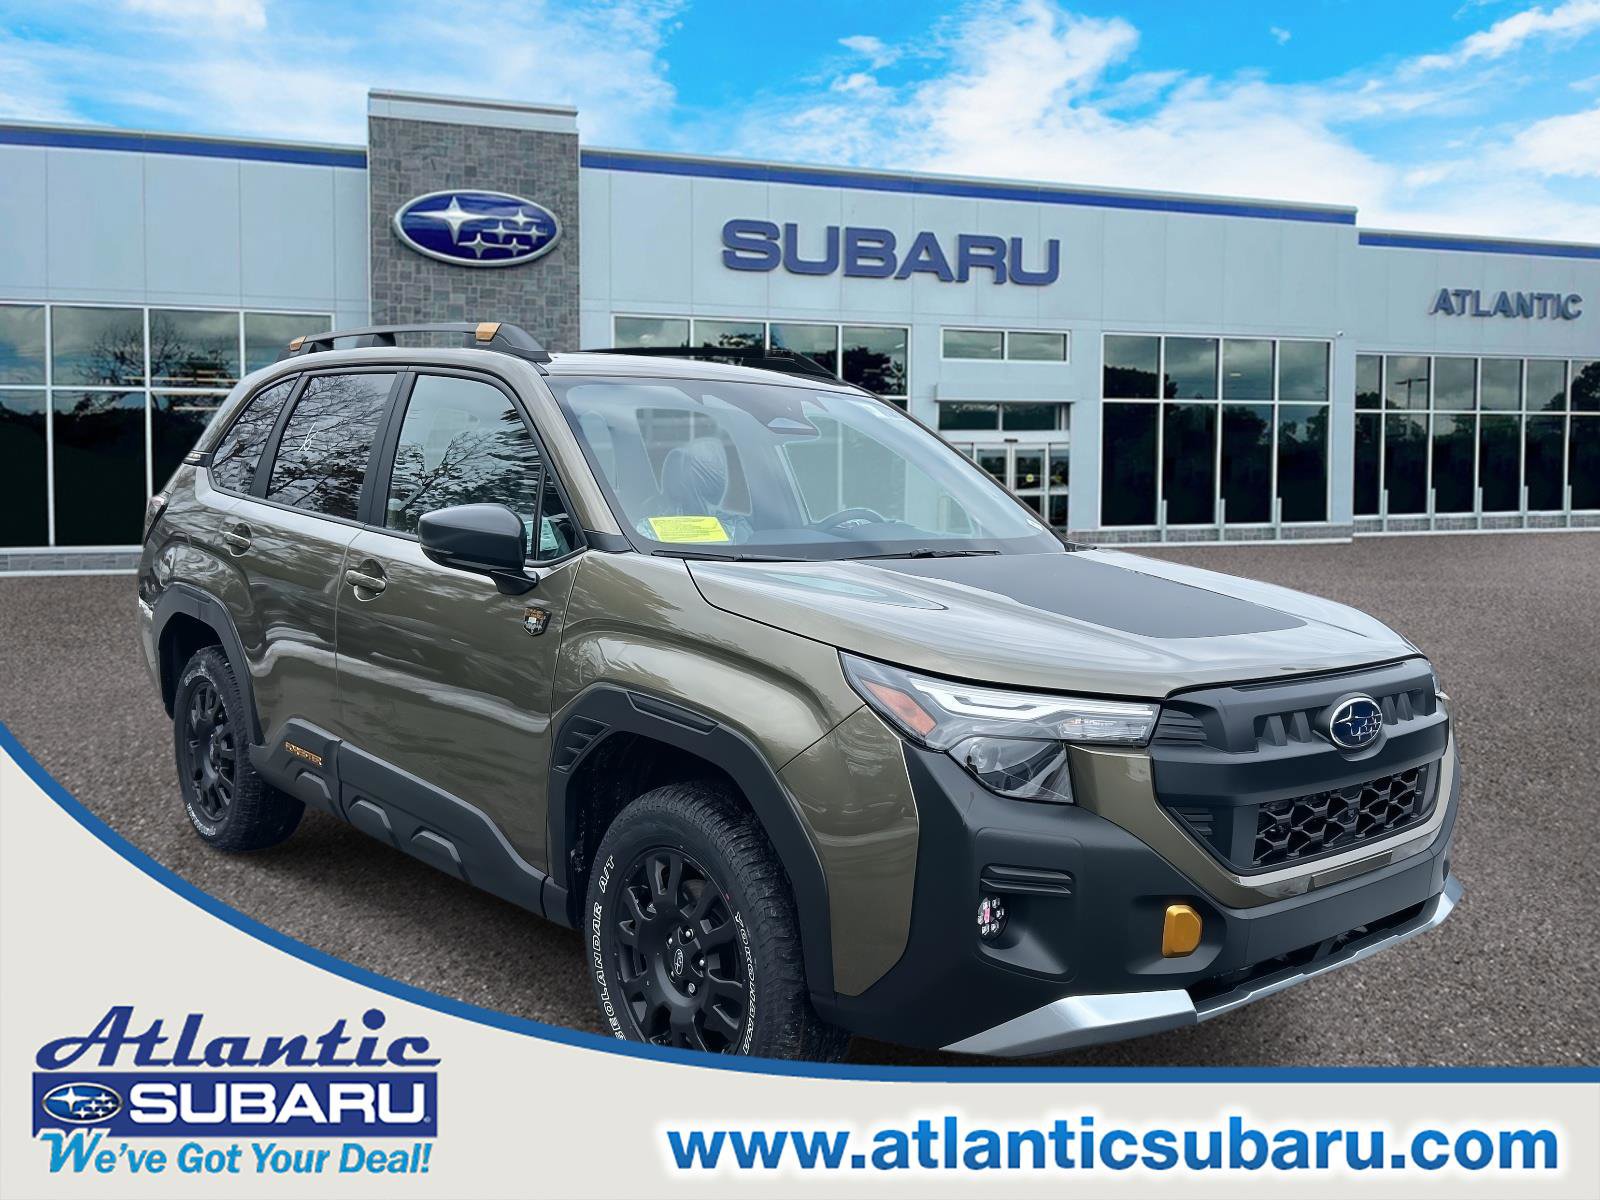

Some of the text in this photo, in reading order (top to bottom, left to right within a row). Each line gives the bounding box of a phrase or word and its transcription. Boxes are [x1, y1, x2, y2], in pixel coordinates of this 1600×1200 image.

[722, 219, 1061, 286] SUBARU
[1429, 288, 1583, 321] ATLANTIC
[598, 854, 615, 894] A/T
